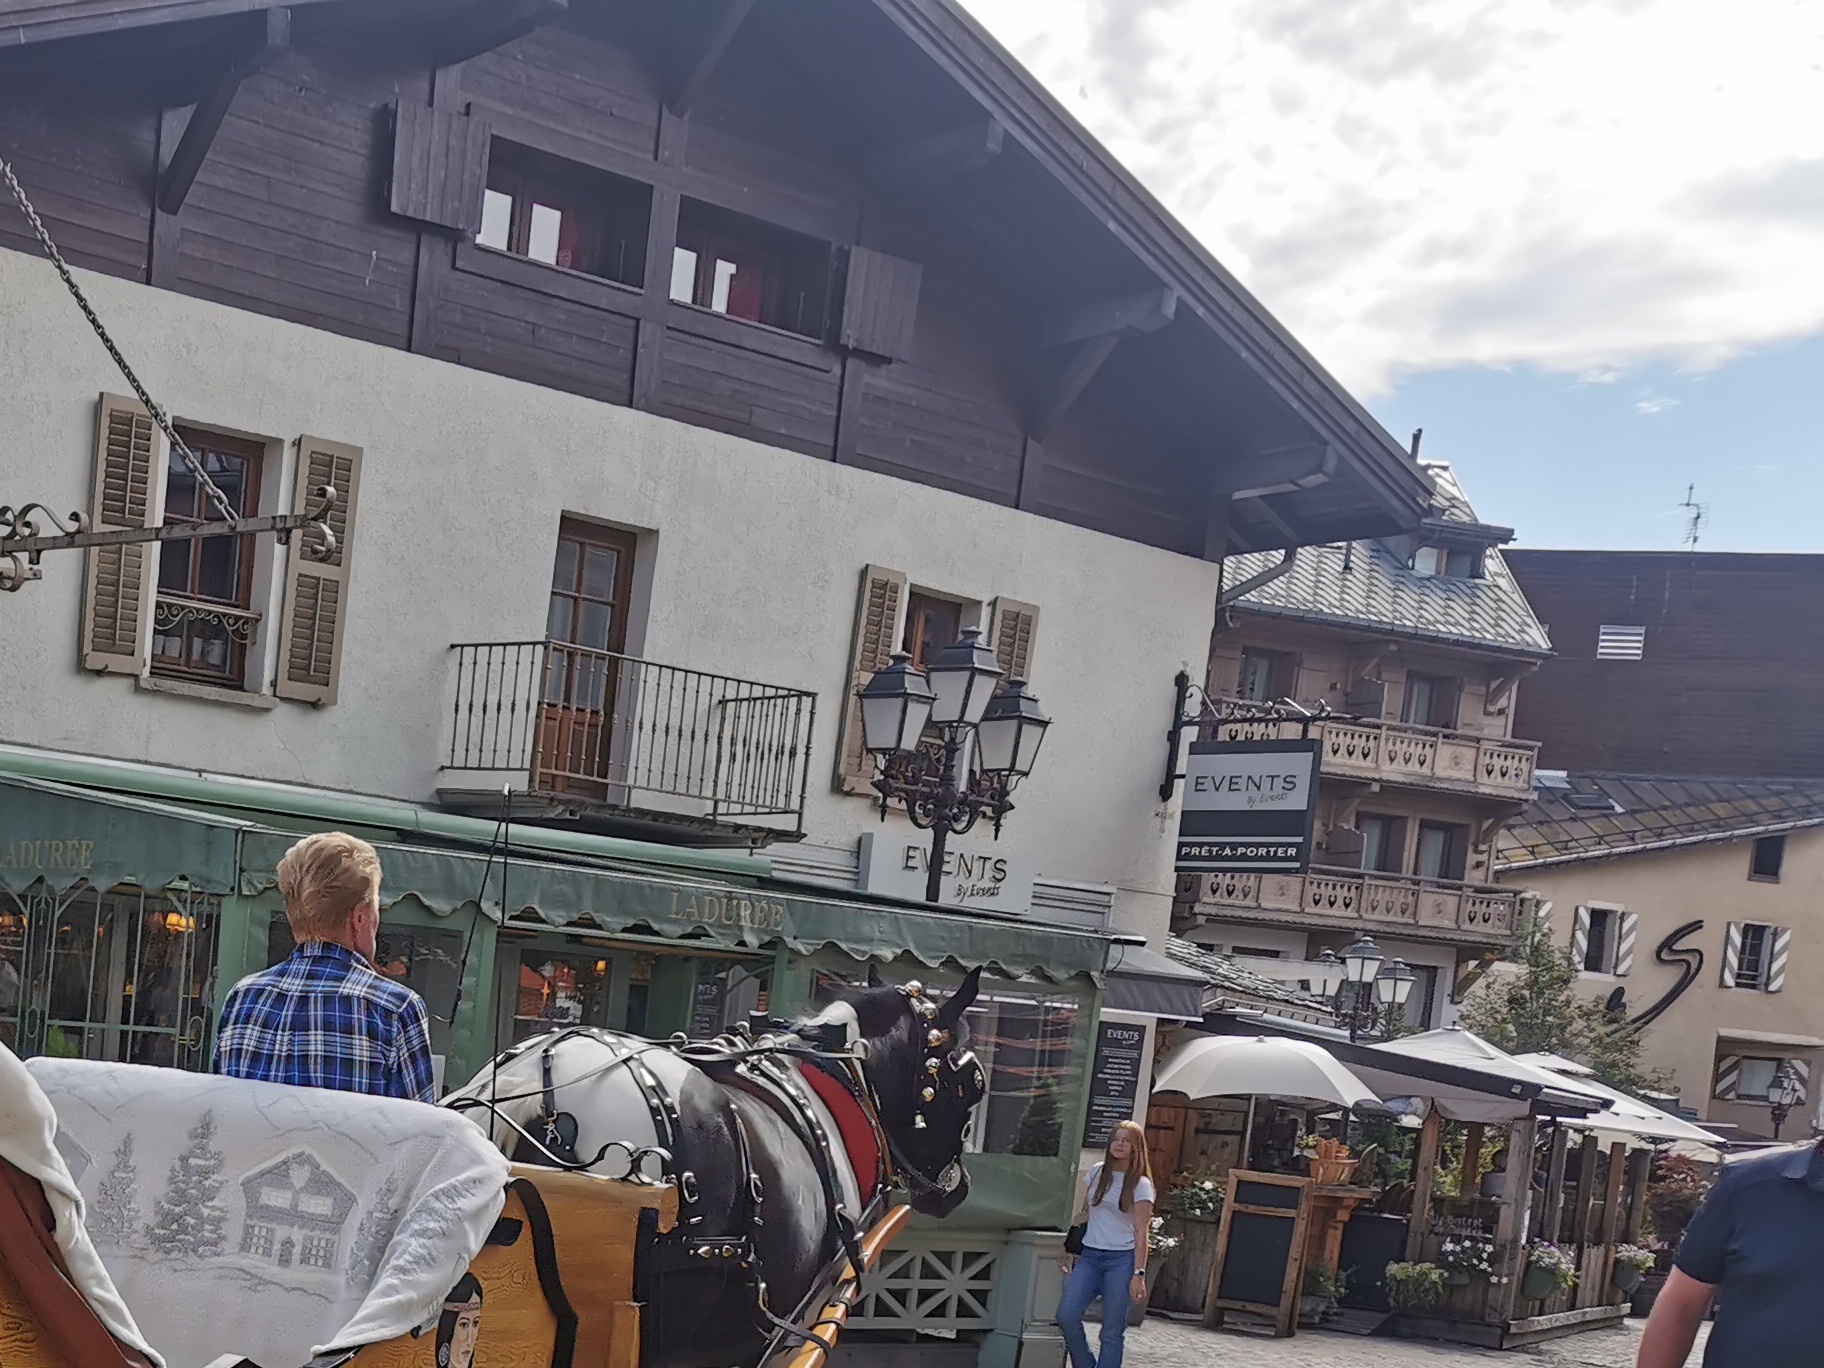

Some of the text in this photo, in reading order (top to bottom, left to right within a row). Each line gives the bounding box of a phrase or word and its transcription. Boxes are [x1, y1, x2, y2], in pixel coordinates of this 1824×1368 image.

[1194, 774, 1298, 793] EVENTS
[1181, 846, 1297, 857] PRÊT-À-PORTER
[955, 883, 1001, 904] By Events
[668, 892, 786, 932] LADURÉE
[1106, 1028, 1140, 1041] EVENTS
